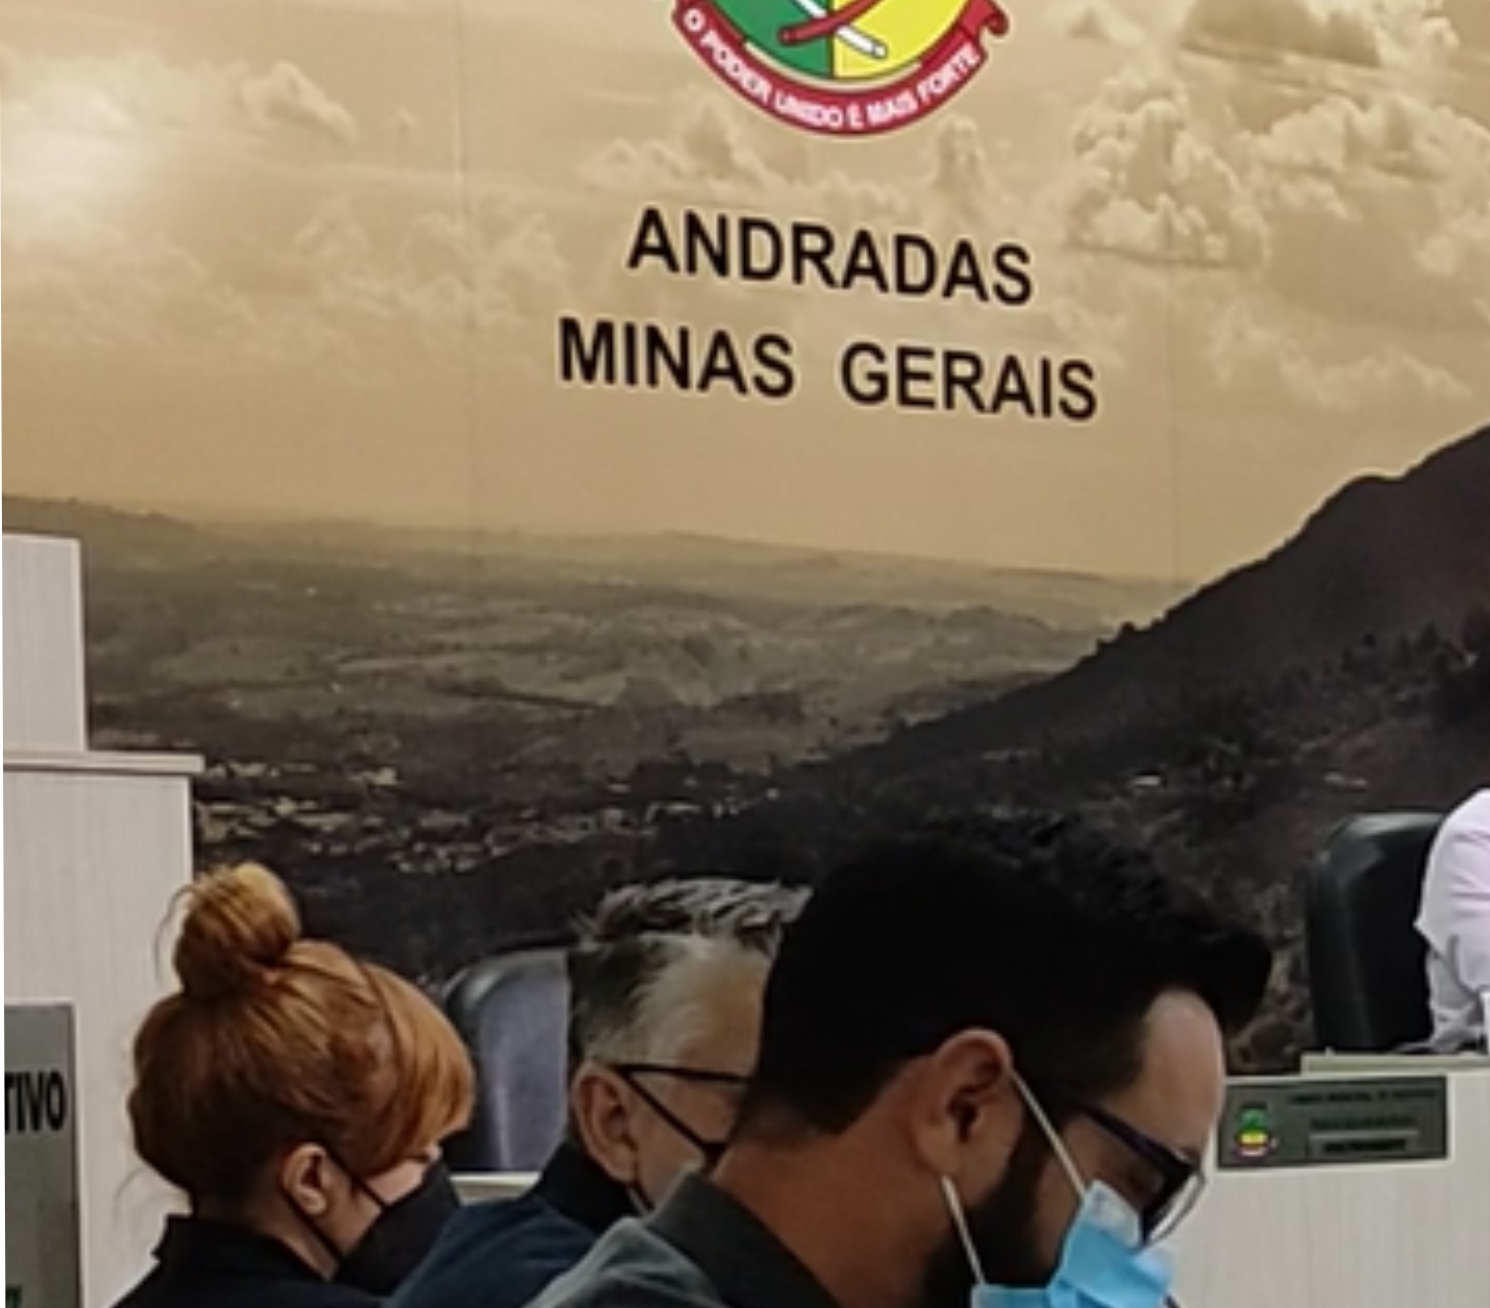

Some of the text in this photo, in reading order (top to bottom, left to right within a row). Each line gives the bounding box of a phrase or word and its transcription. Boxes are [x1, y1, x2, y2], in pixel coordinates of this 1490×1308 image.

[684, 8, 706, 31] O
[700, 29, 772, 104] PODER
[774, 91, 844, 128] UNIDO
[866, 90, 919, 126] MAIS
[917, 42, 981, 103] FORTE
[628, 207, 1032, 305] ANDRADAS
[558, 317, 1097, 420] MINAS GERAIS
